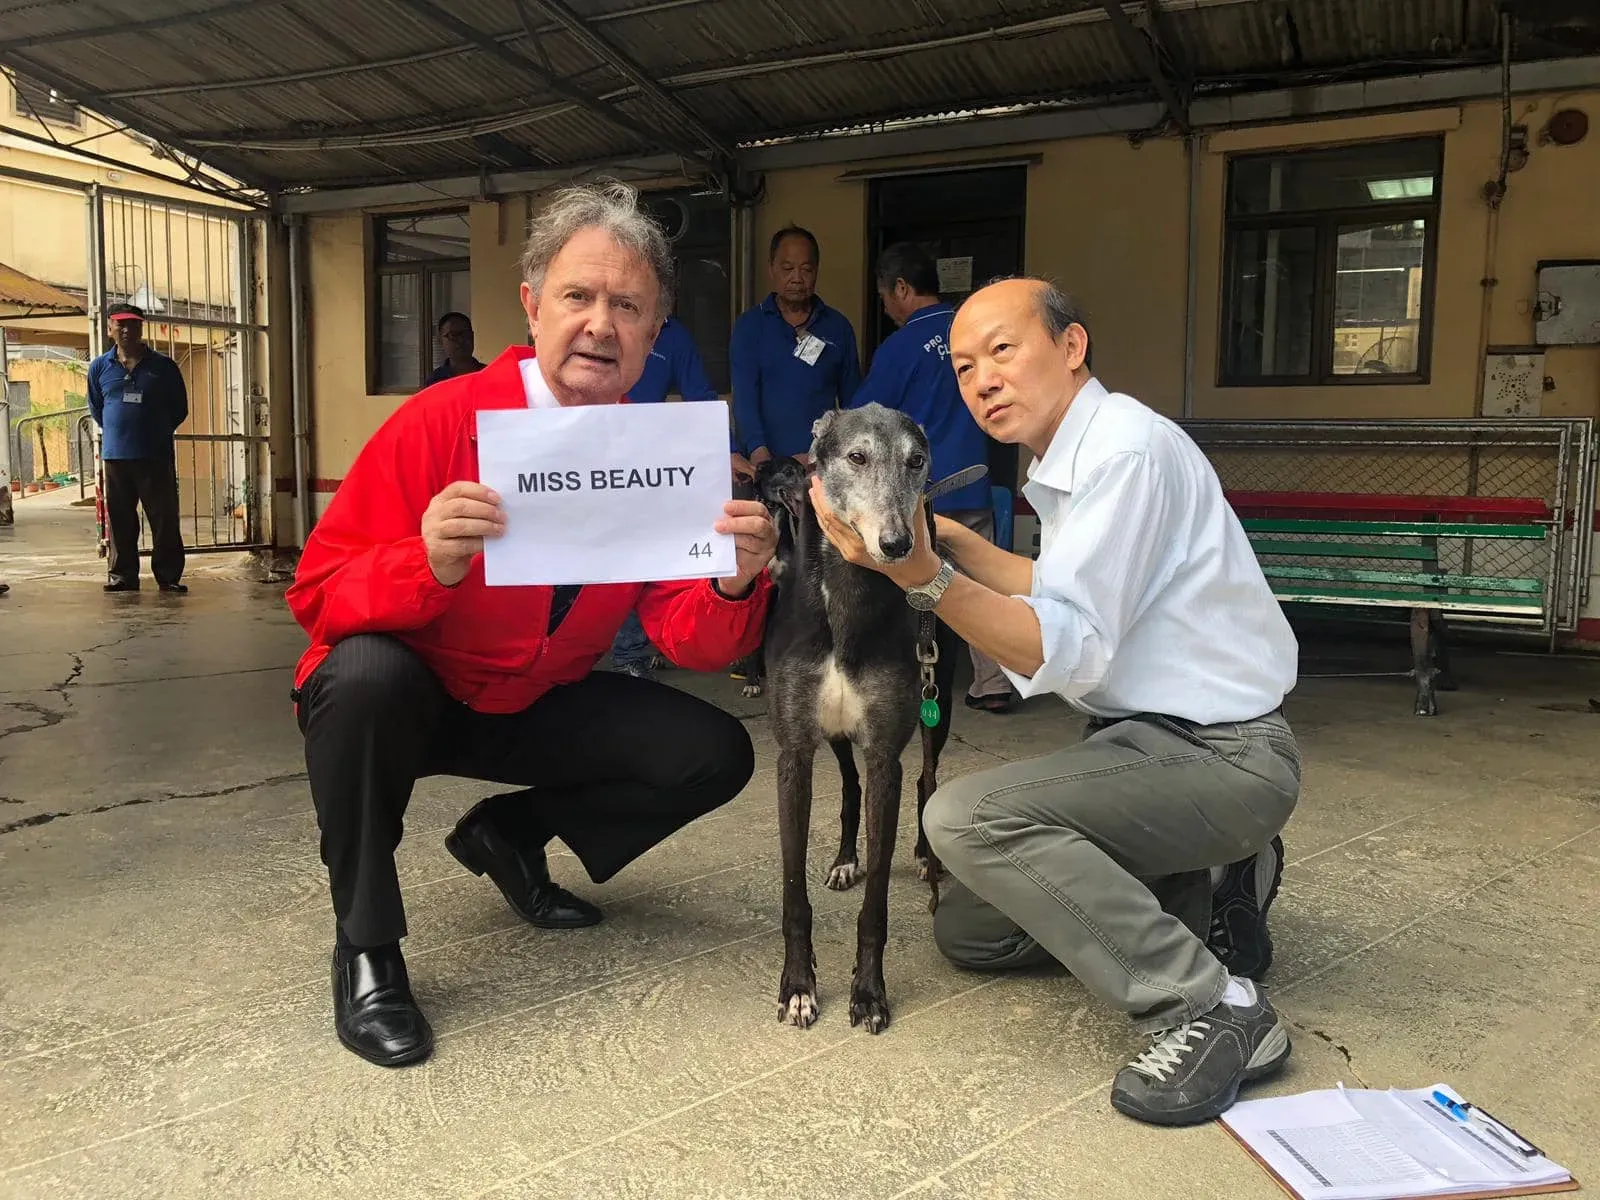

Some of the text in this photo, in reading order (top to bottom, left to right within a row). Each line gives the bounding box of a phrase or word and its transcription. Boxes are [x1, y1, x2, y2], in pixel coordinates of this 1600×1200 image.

[923, 334, 943, 353] PRO
[518, 466, 695, 493] MISS BEAUTY
[688, 542, 713, 559] 44
